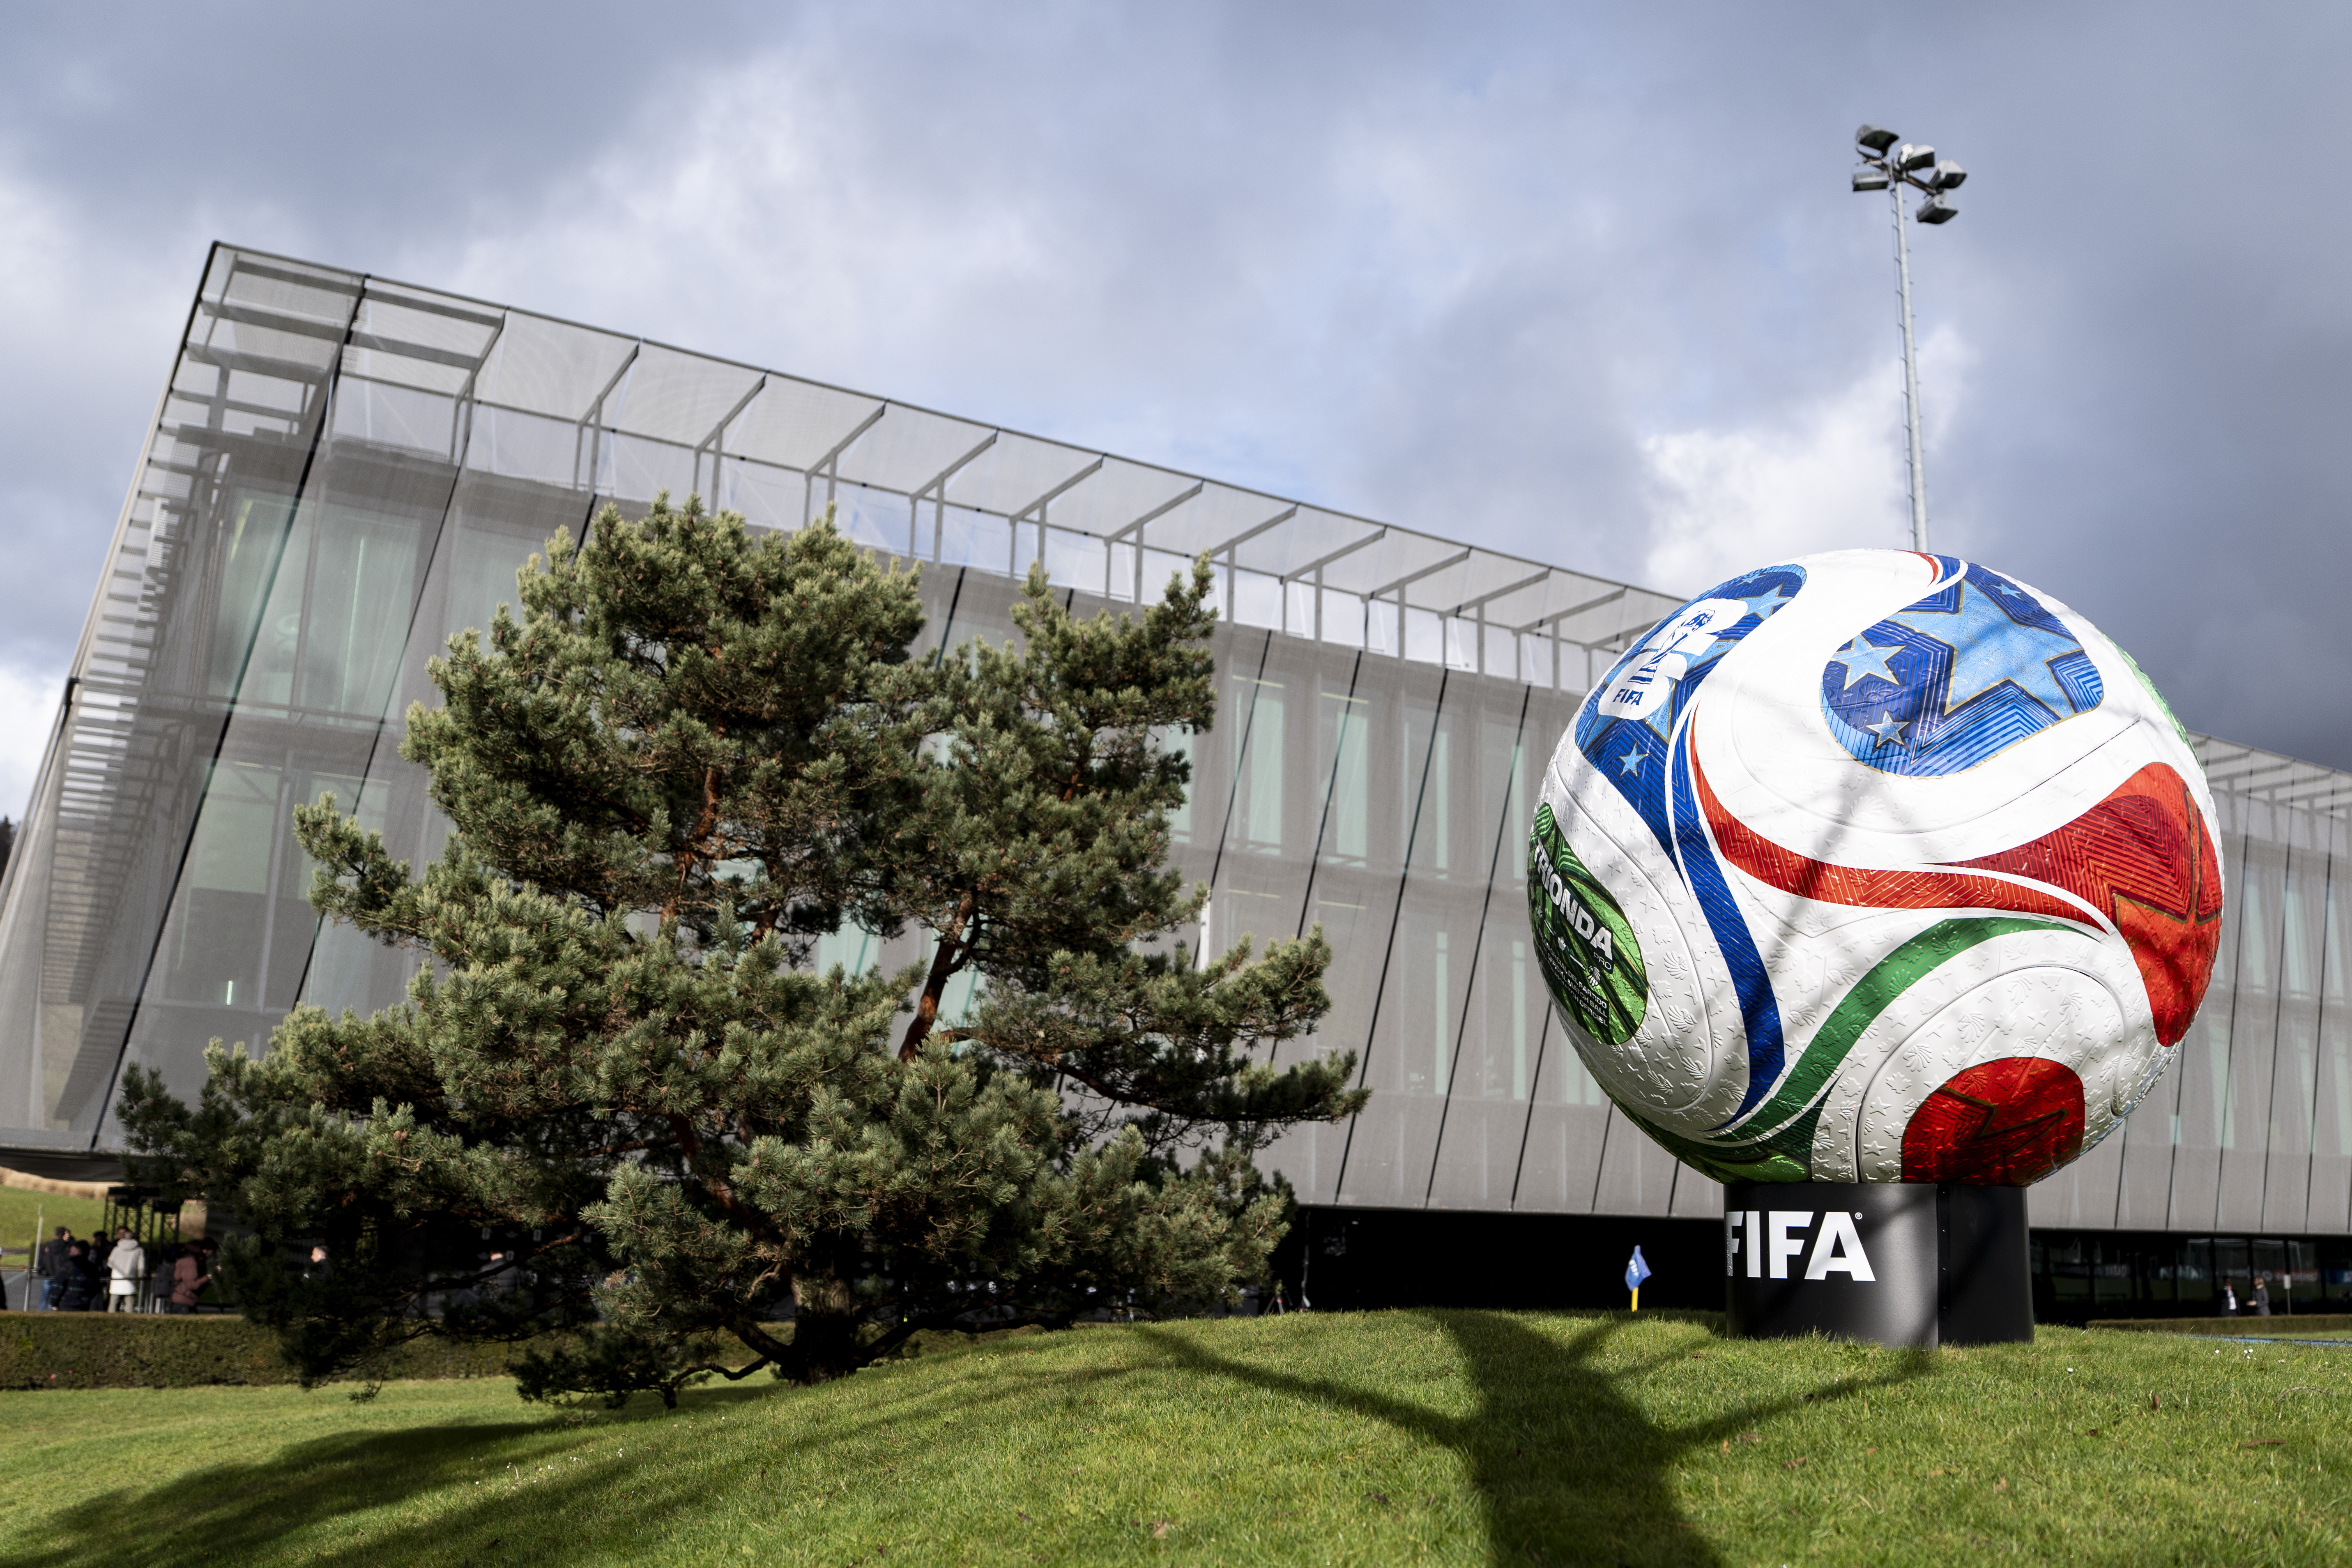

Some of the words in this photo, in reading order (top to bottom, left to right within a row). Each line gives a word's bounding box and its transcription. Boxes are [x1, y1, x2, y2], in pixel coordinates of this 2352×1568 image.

[1613, 688, 1644, 706] FIFA
[1534, 834, 1613, 960] TRIONDA
[1594, 952, 1611, 969] PRO
[1567, 979, 1588, 1003] MATCH
[1590, 1000, 1607, 1018] BALL
[1568, 970, 1578, 985] DEL
[1579, 981, 1607, 1008] PARTIDO
[1579, 999, 1608, 1027] OFFICIEL
